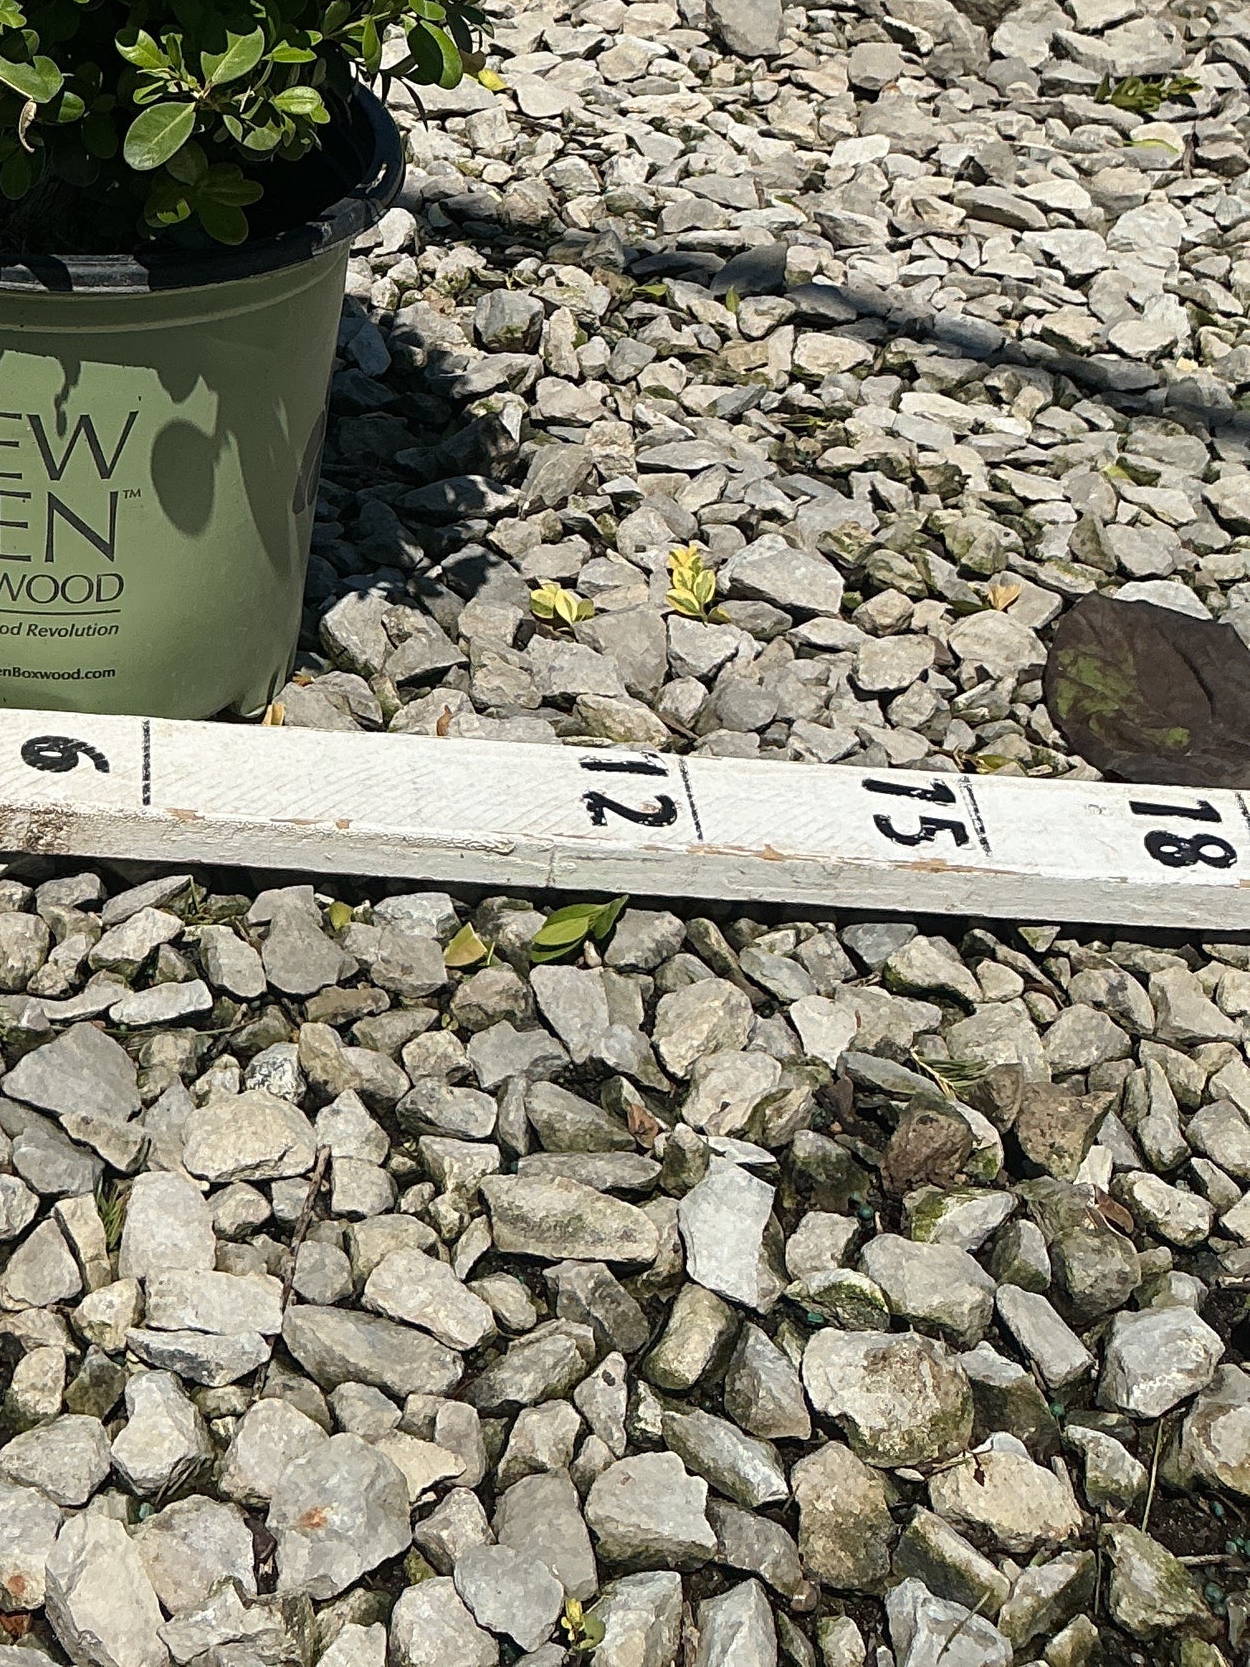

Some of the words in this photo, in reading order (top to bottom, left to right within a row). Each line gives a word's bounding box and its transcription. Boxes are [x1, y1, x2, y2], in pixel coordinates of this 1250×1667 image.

[26, 621, 120, 638] Revolution
[21, 735, 110, 773] 6
[578, 750, 678, 827] 12
[861, 778, 970, 847] 15
[1128, 799, 1237, 870] 18
